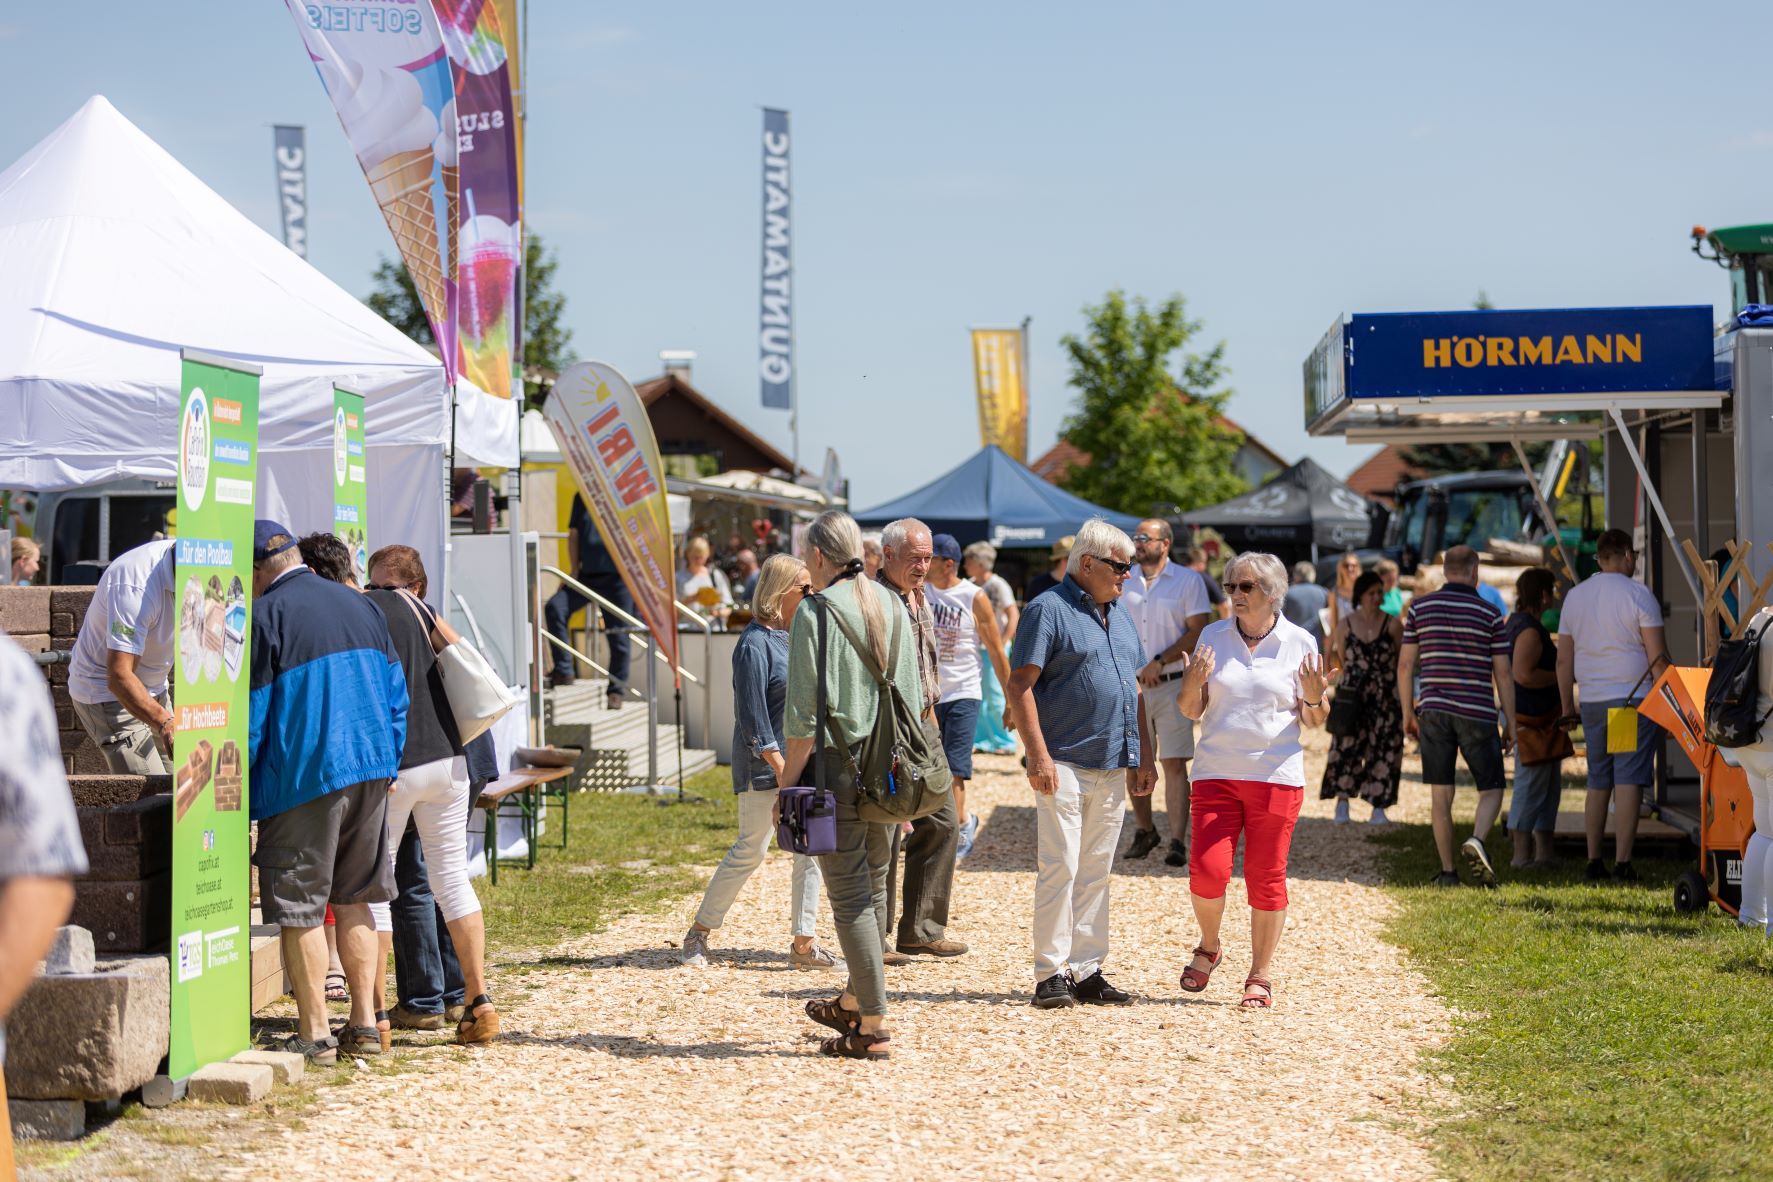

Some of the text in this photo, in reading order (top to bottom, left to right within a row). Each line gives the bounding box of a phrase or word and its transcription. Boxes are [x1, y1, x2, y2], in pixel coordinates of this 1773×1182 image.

[1423, 333, 1642, 368] HÖRMANN
[194, 540, 206, 565] den
[208, 543, 232, 566] Poolbau
[931, 602, 962, 627] NIM
[193, 704, 225, 728] Hochbeete
